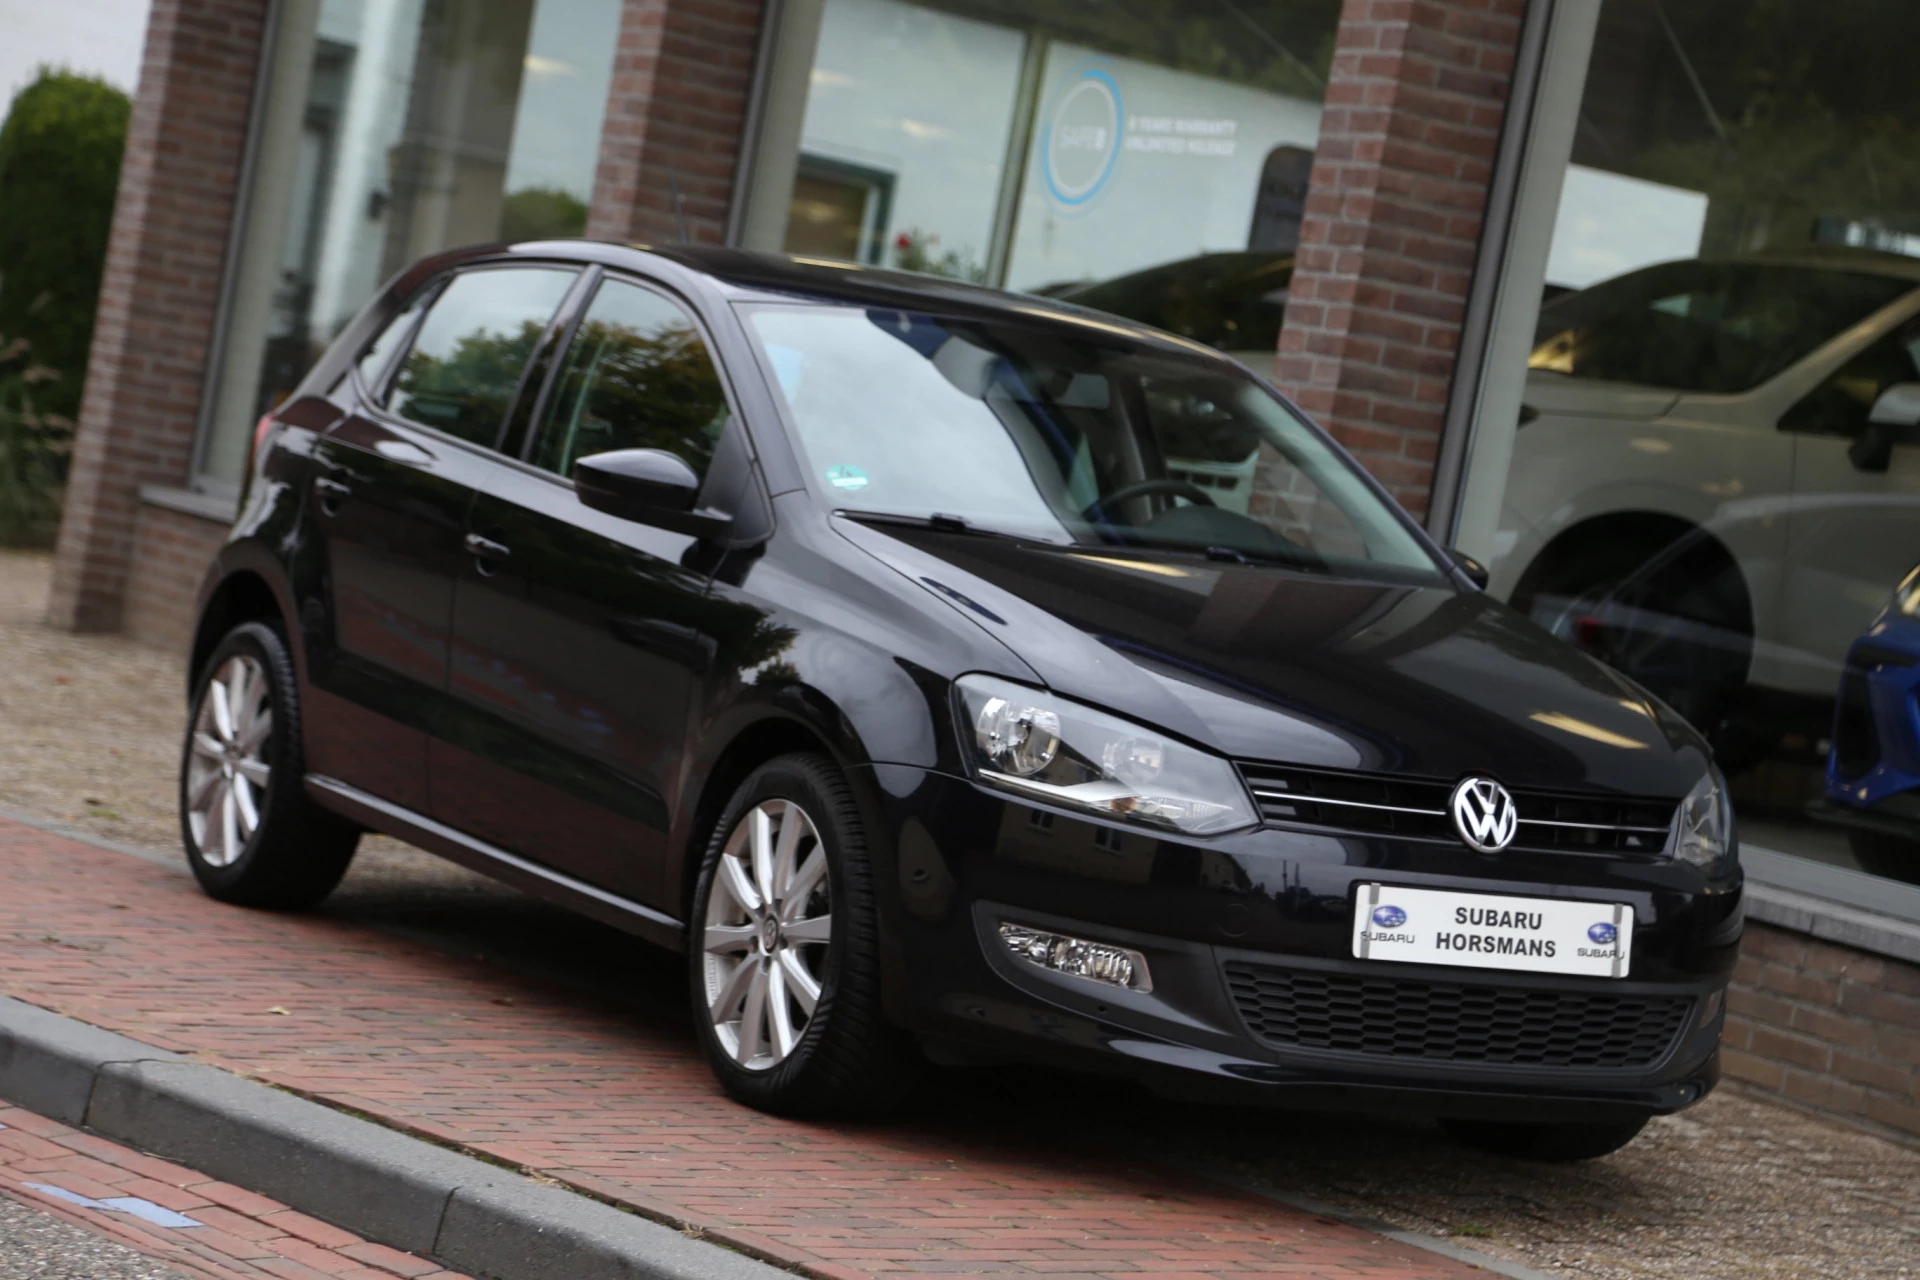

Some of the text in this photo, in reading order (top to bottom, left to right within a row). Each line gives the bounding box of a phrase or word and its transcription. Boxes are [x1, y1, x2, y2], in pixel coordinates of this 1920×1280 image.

[1454, 906, 1543, 930] SUBARU
[1360, 931, 1415, 944] SUBARU
[1436, 931, 1557, 958] HORSMANS
